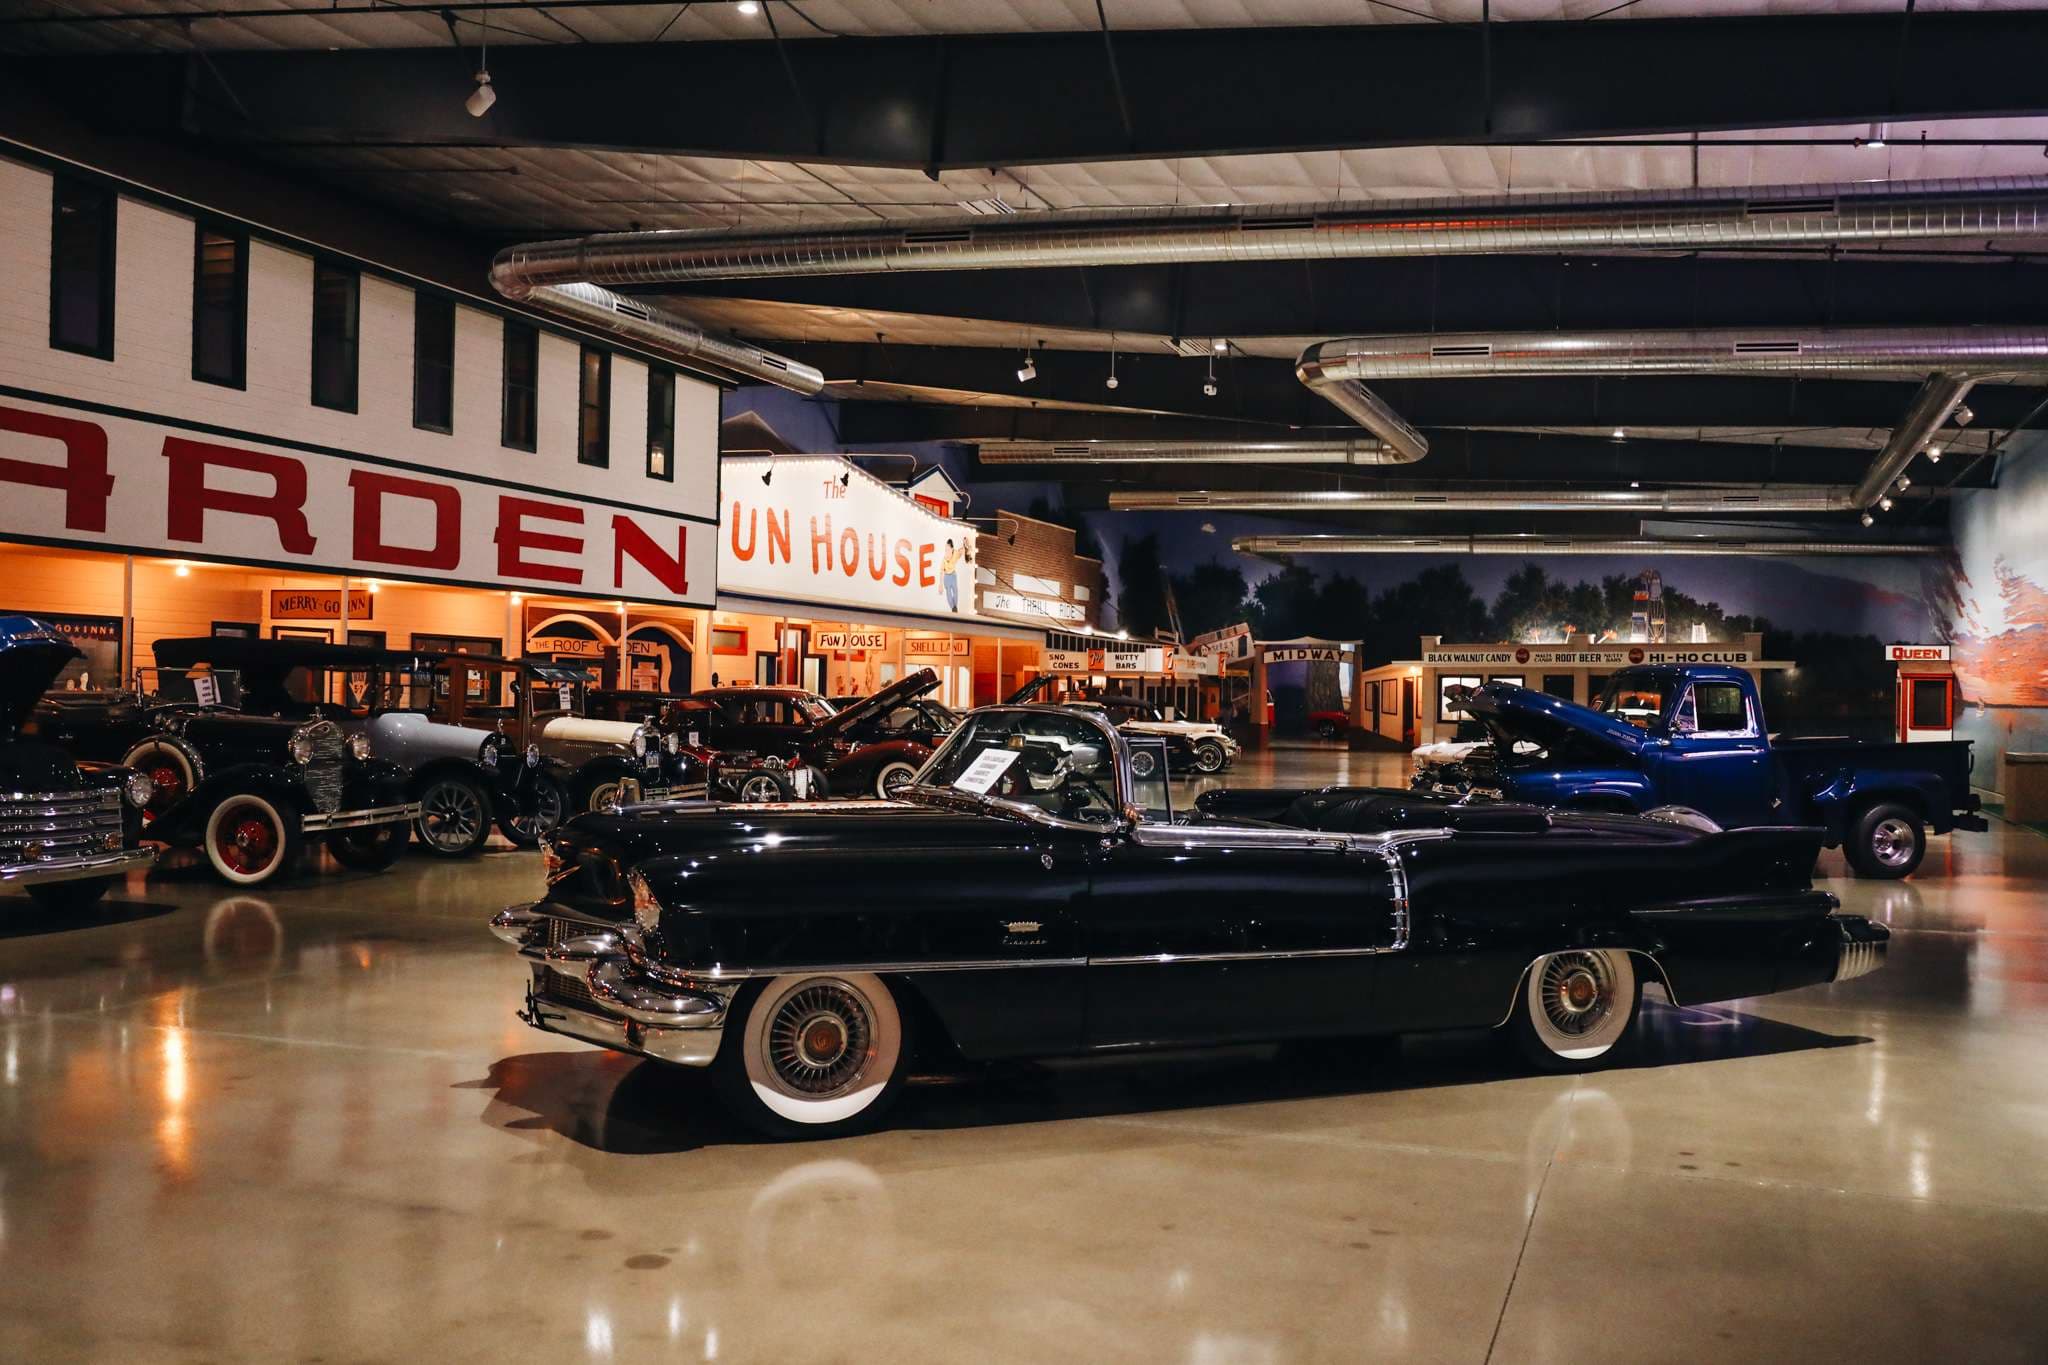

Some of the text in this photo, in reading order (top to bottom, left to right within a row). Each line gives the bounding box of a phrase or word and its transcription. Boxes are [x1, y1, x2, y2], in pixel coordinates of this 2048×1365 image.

[824, 476, 846, 499] The
[0, 407, 688, 595] ARDEN
[720, 492, 935, 588] UN HOUSE
[279, 595, 318, 612] MERRY
[324, 600, 340, 613] GO
[83, 625, 106, 633] INN
[535, 639, 650, 654] THE ROOF GDEN
[820, 634, 840, 647] FUN
[911, 642, 963, 653] SHELL LAND
[1892, 647, 1942, 660] QUEEN
[1273, 650, 1345, 661] MIDWAY
[1428, 653, 1453, 662] BLACK
[1454, 653, 1485, 662] WALNUT
[1486, 654, 1511, 662] CANDY
[1555, 654, 1601, 662] ROOT BEER
[1701, 653, 1748, 662] CLUB
